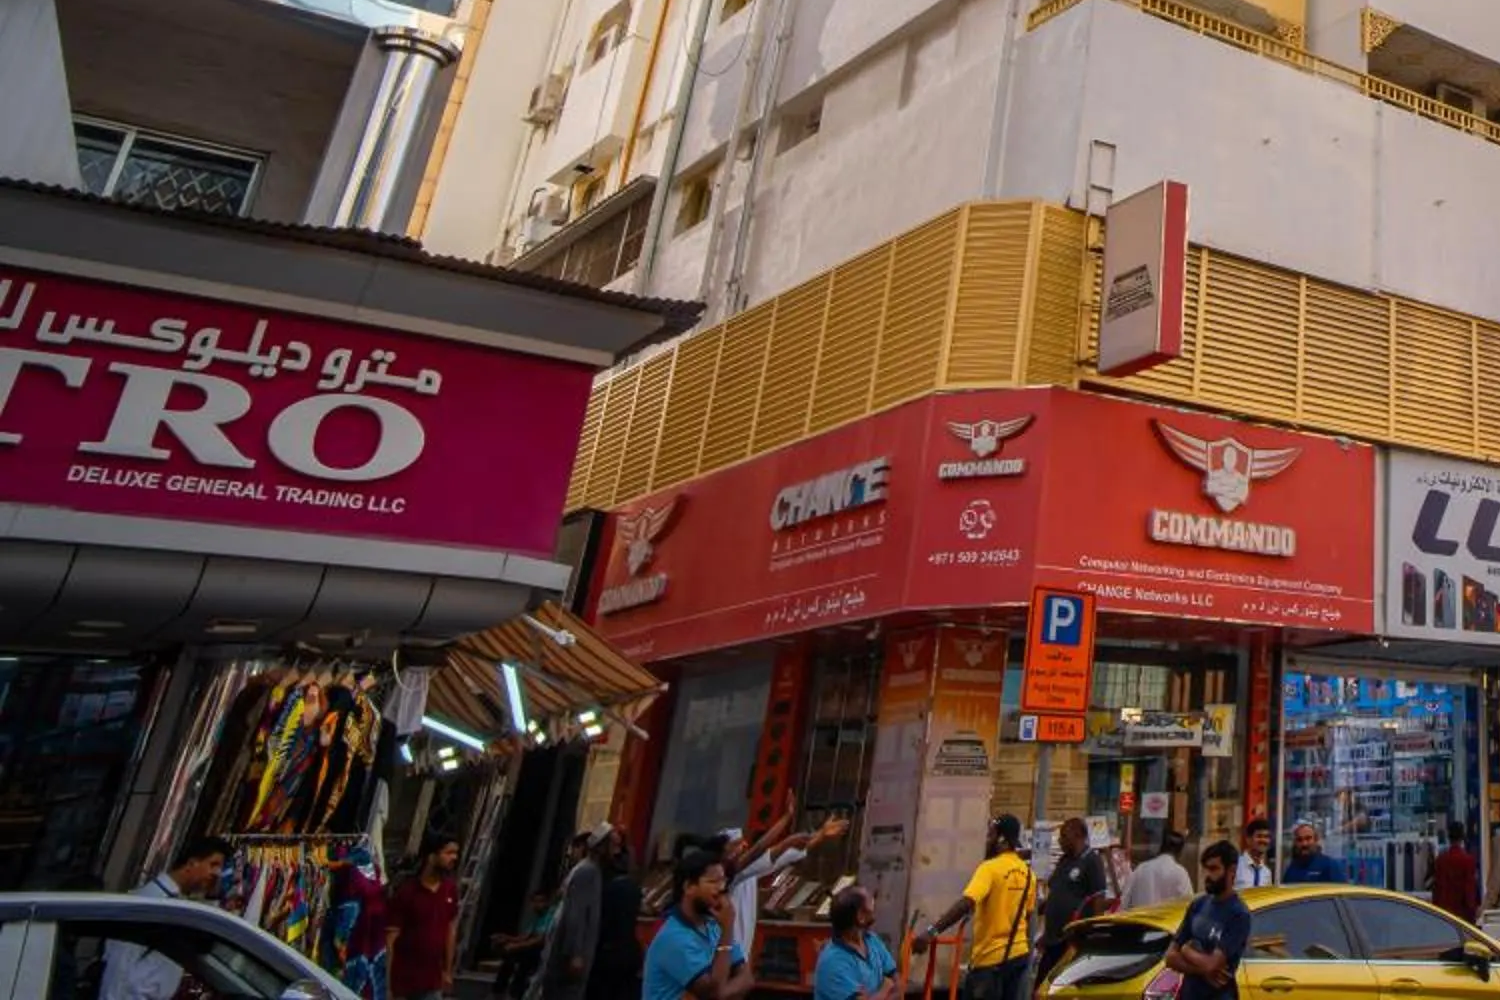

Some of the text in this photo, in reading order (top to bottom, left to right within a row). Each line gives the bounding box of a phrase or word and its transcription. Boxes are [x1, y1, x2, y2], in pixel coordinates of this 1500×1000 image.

[36, 311, 442, 395] مترو ديلوكس
[67, 464, 406, 514] DELUXE GENERAL TRADING LLC
[938, 458, 1026, 479] COMMANDO
[1149, 507, 1297, 558] COMMANDO
[1079, 555, 1129, 573] Computer
[1131, 560, 1185, 579] Networking
[1048, 597, 1076, 641] P
[1135, 588, 1189, 606] Networks
[1191, 594, 1214, 608] LLC
